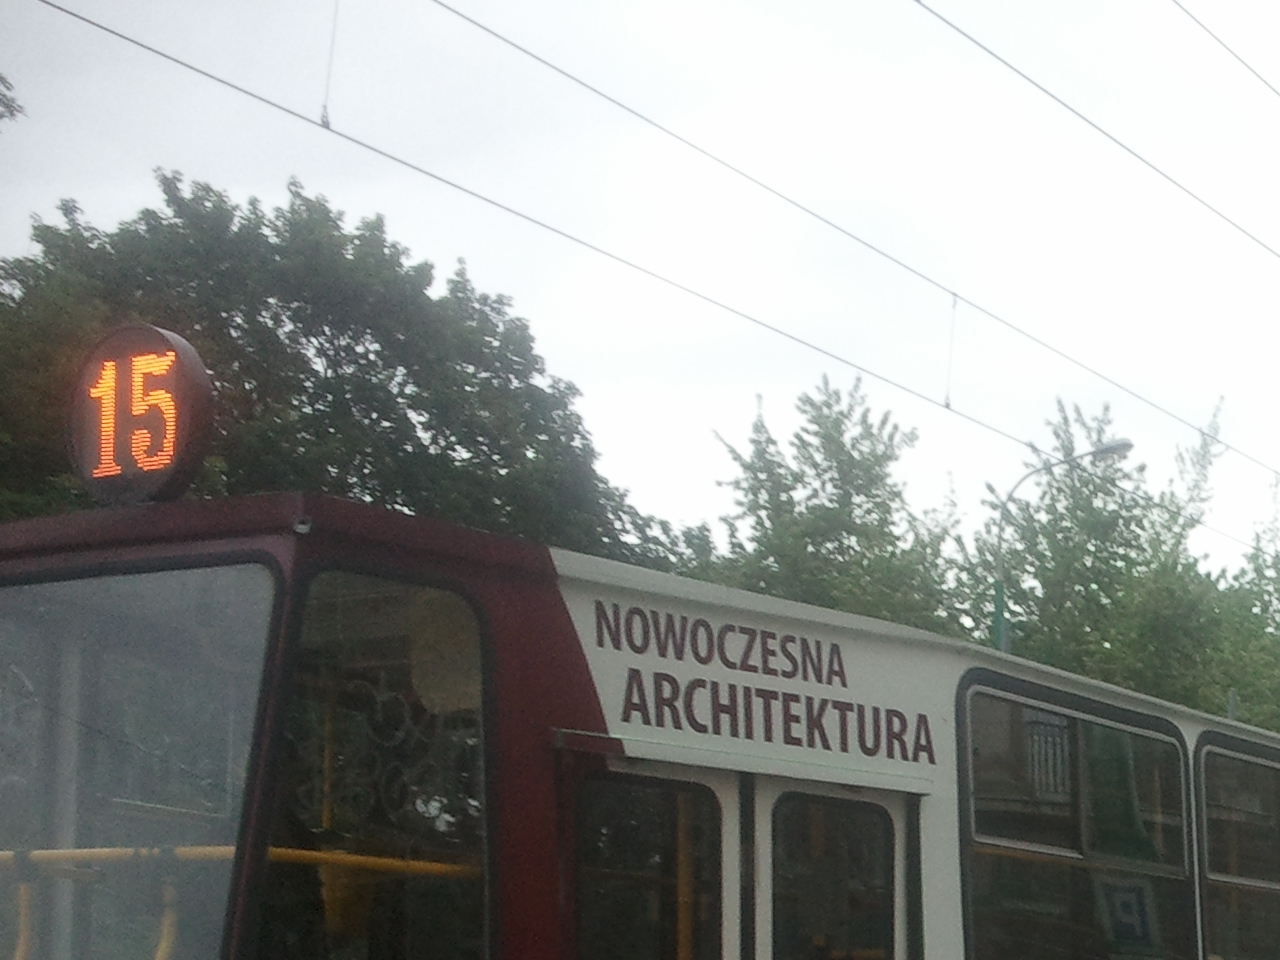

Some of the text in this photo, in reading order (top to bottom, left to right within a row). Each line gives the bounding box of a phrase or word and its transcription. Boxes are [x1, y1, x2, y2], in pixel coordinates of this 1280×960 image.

[88, 351, 176, 478] 15
[595, 600, 848, 689] NOWOCZESNA
[621, 667, 937, 766] ARCHITEKTURA
